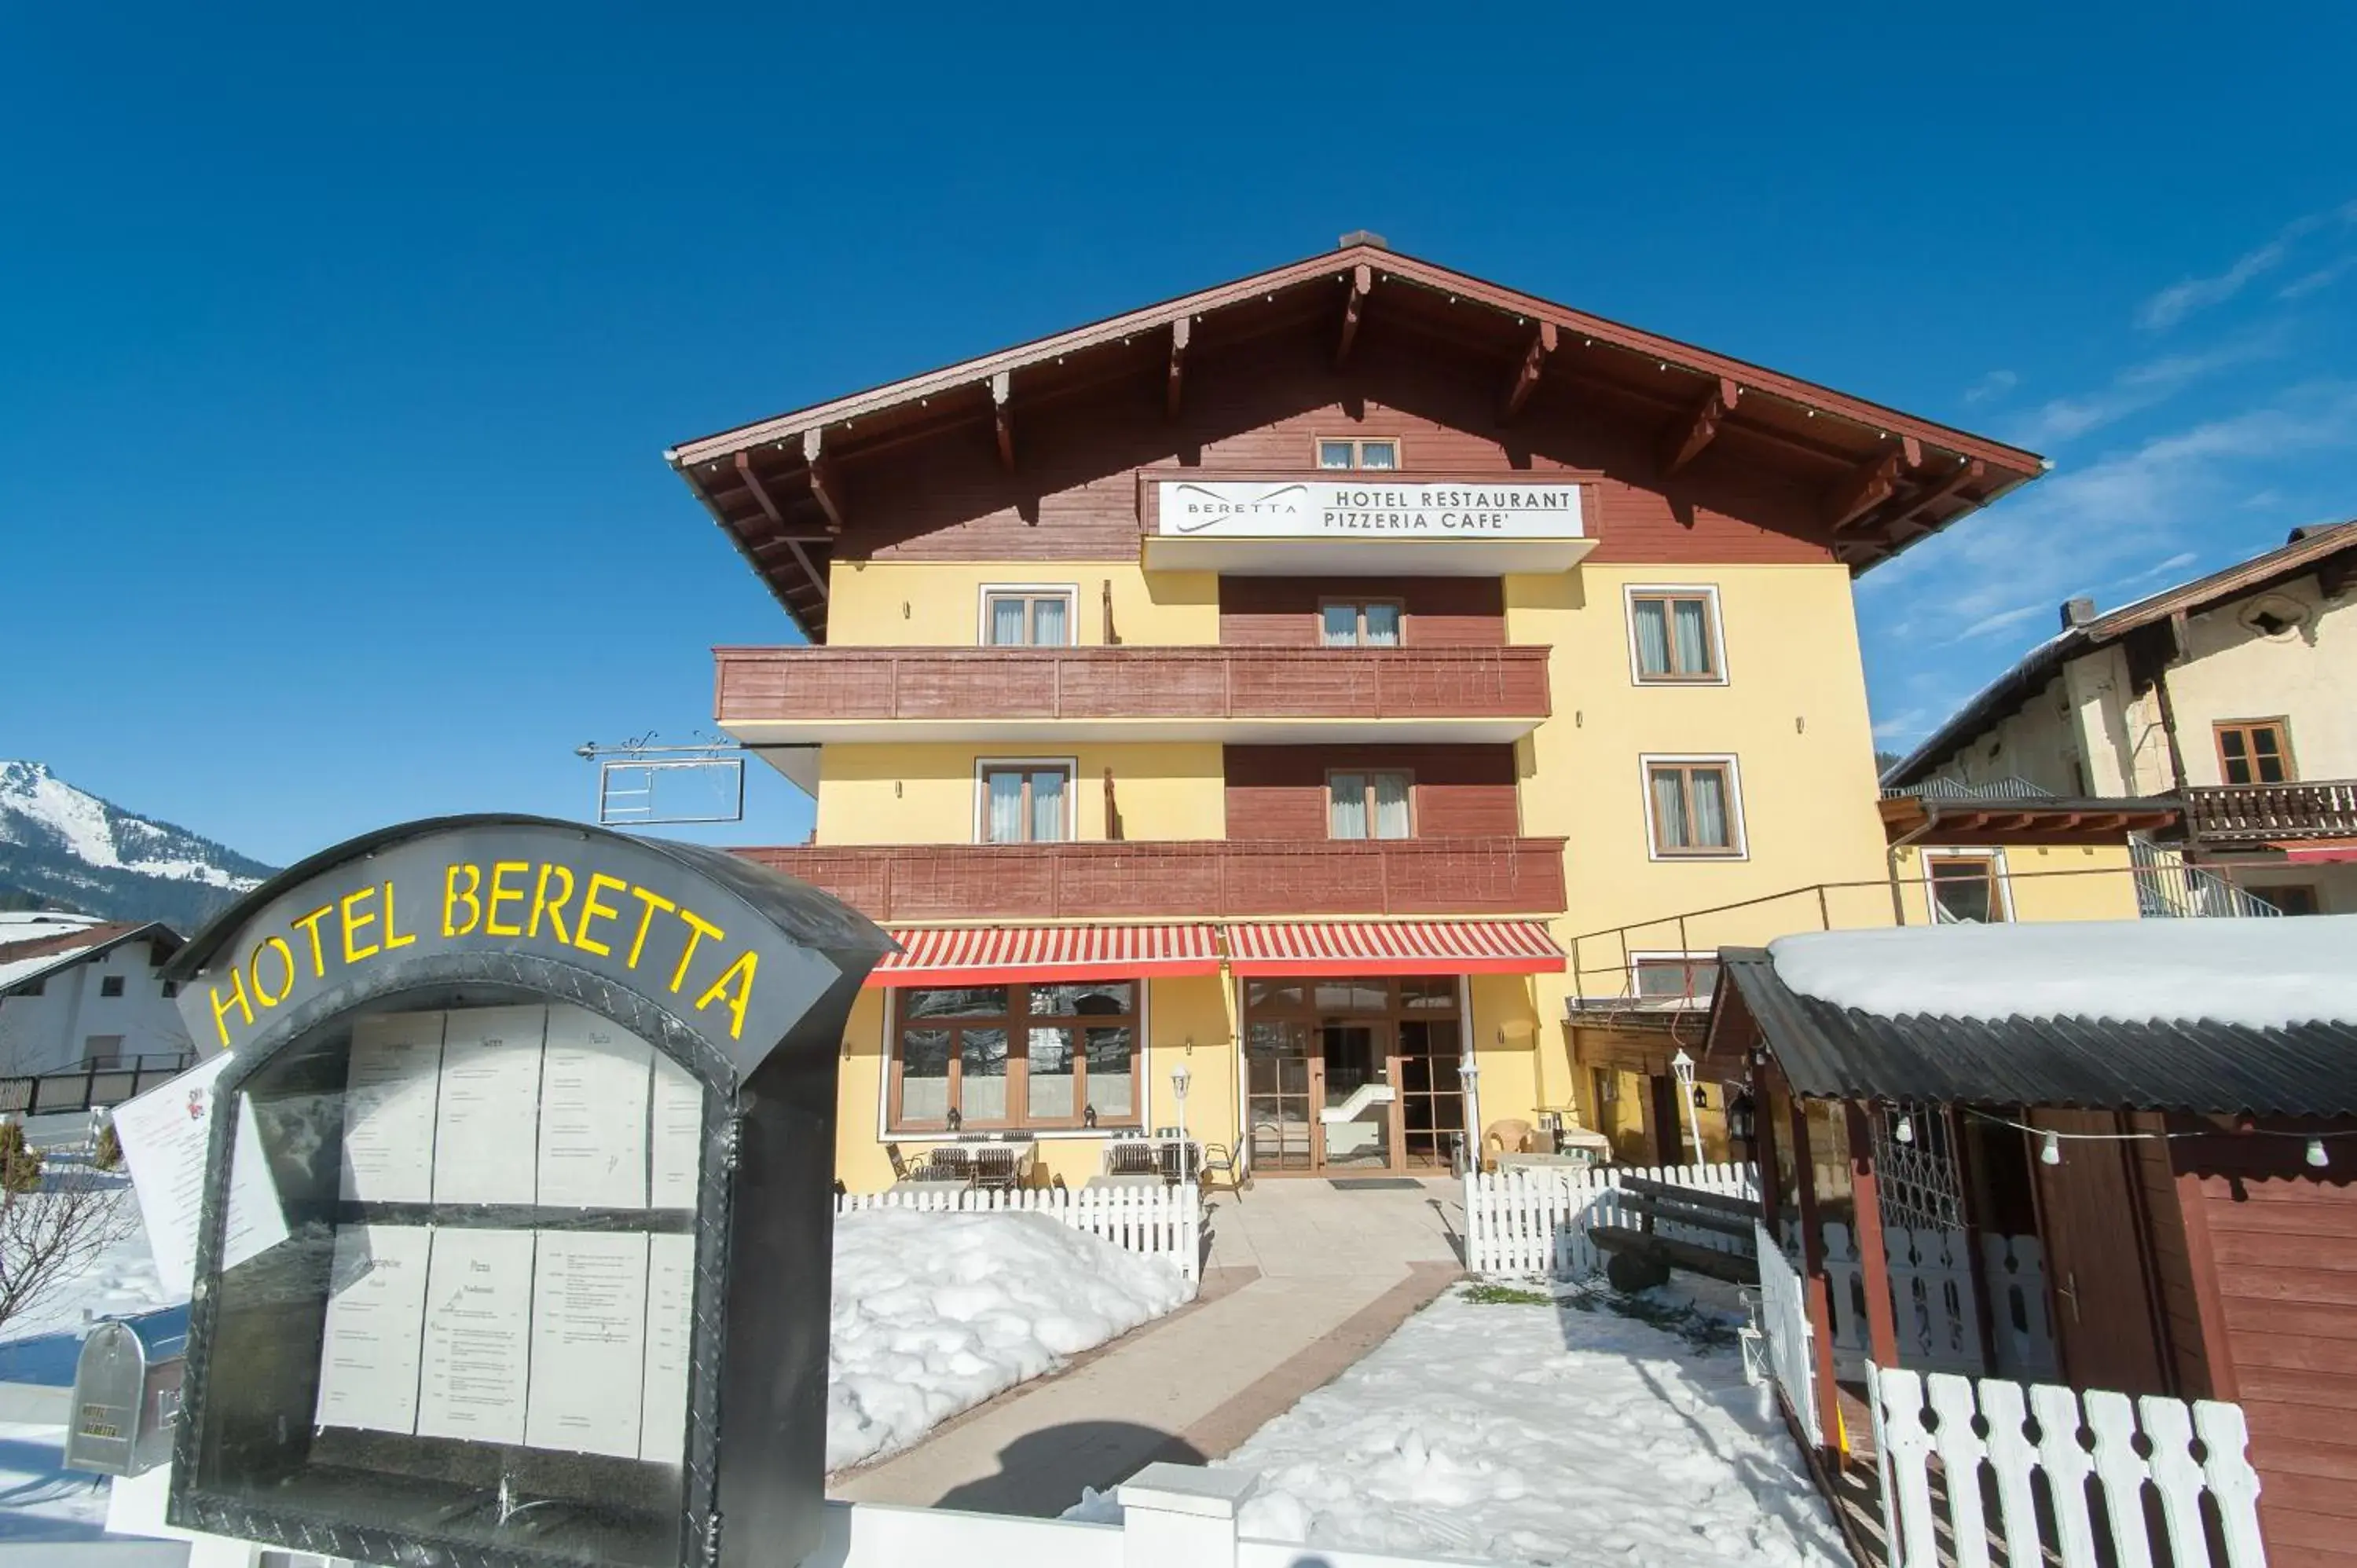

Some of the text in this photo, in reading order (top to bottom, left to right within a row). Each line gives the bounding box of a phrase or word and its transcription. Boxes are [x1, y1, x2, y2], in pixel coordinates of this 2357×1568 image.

[1336, 492, 1570, 507] HOTEL RESTAURANT
[1188, 504, 1296, 513] BERETTA
[1325, 513, 1508, 529] PIZZERIA CAFE'
[209, 861, 759, 1047] HOTEL BERETTA
